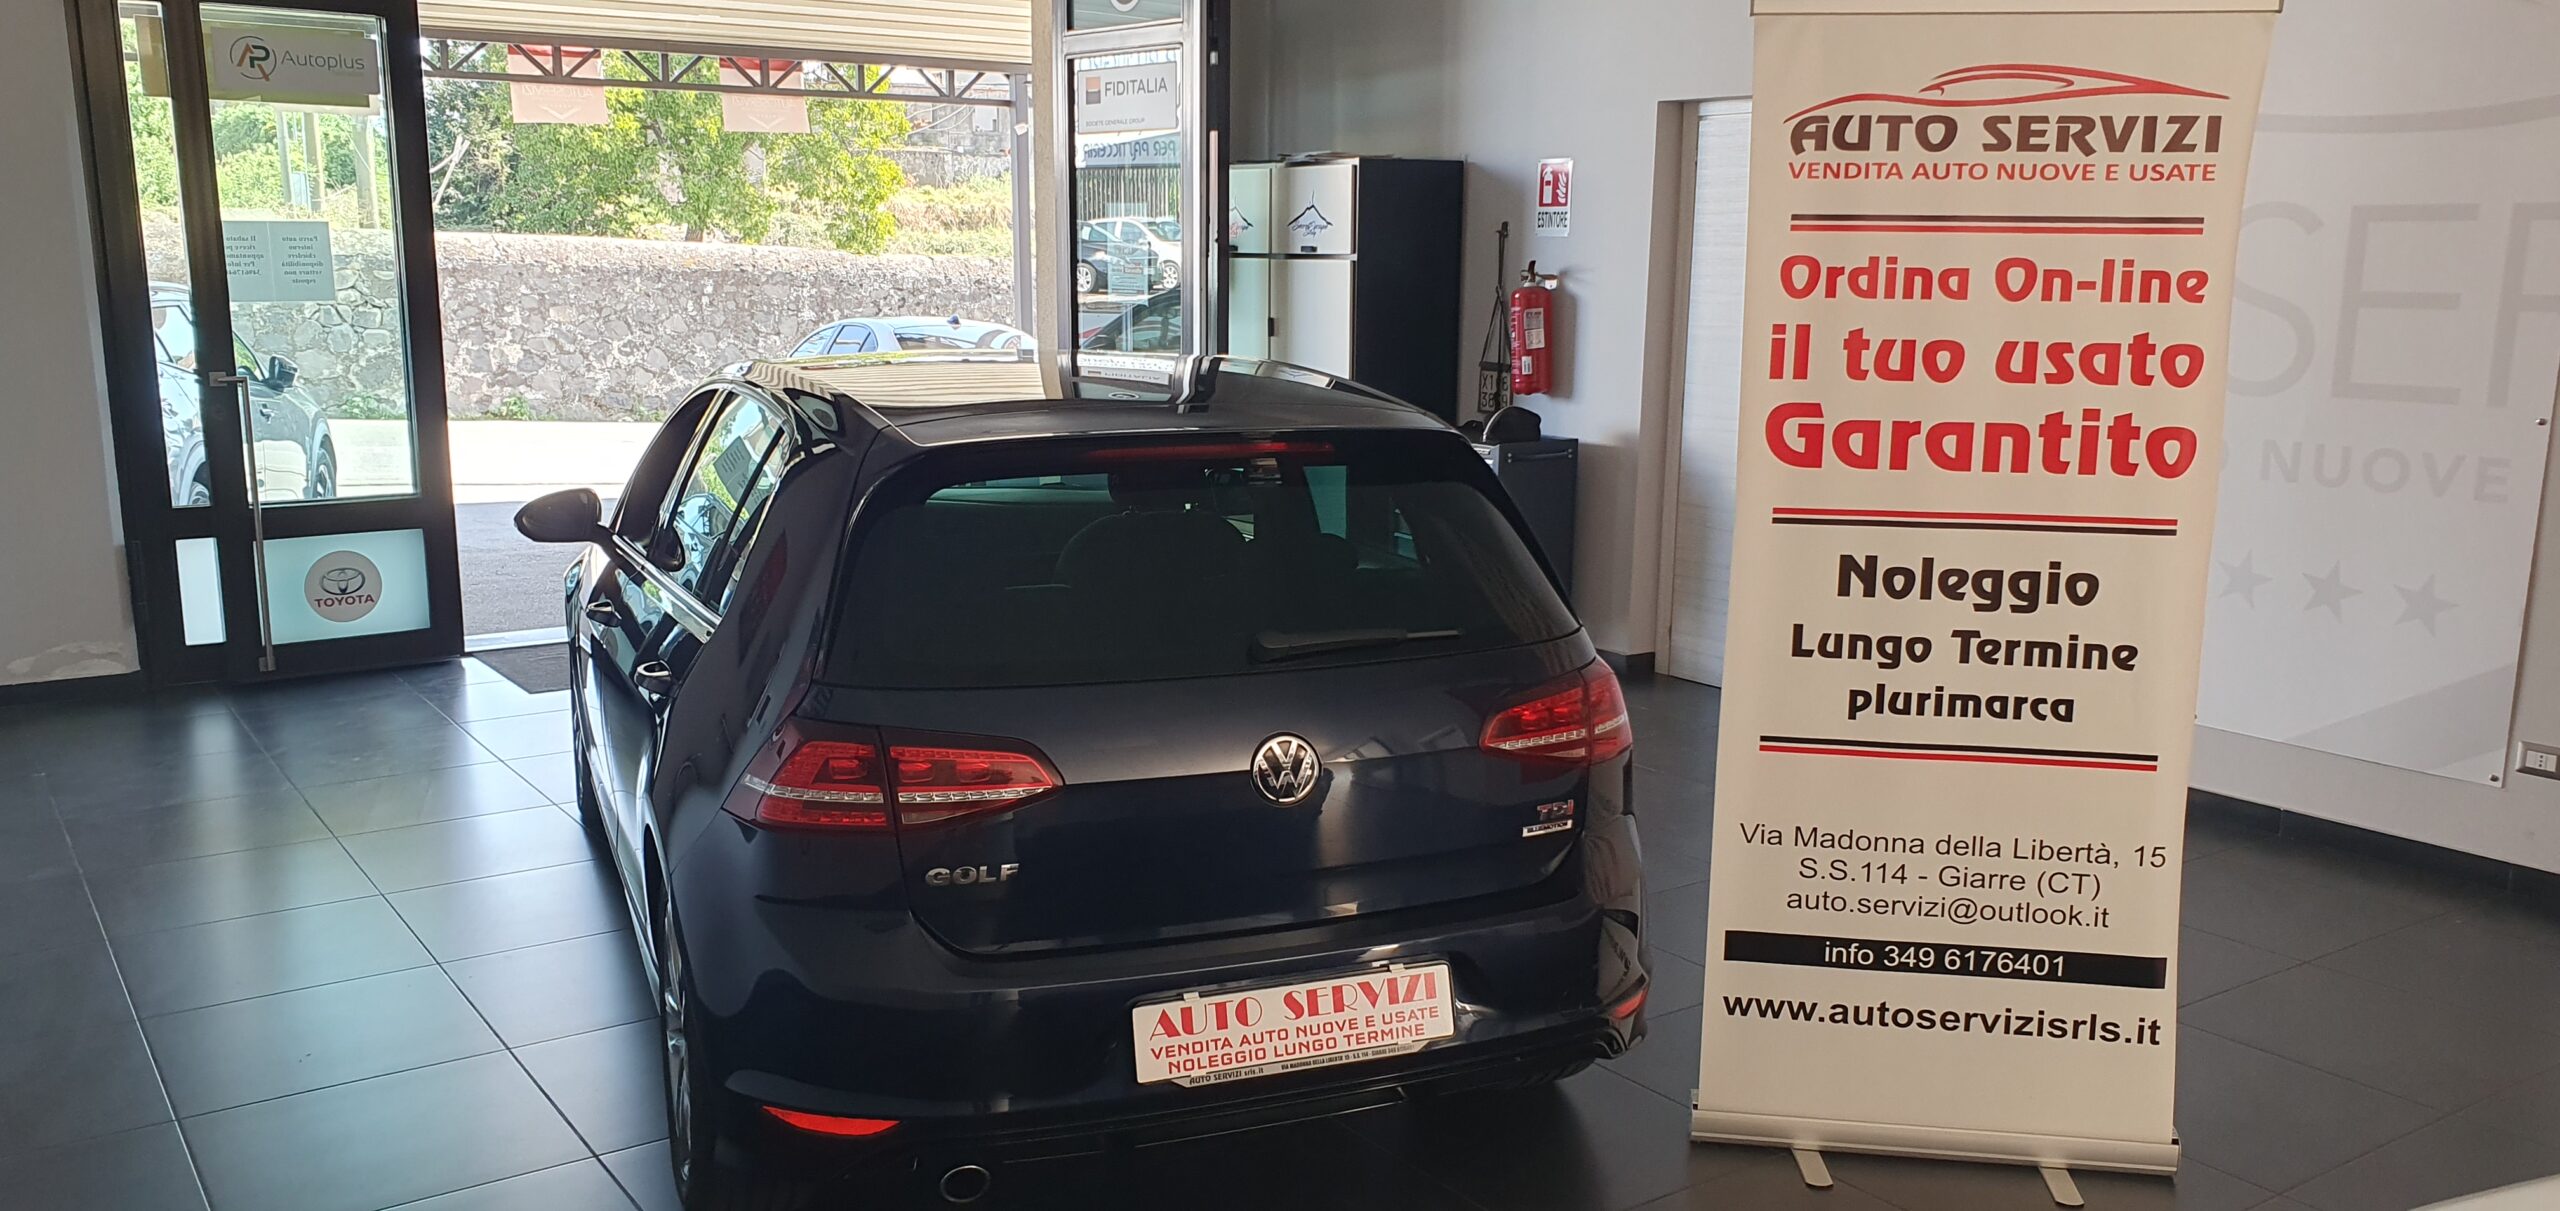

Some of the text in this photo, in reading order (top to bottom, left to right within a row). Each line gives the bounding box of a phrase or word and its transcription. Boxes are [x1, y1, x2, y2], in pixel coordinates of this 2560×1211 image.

[281, 50, 366, 71] Autoplus
[1104, 76, 1168, 97] FIDITALIA
[1789, 114, 2223, 158] AUTO SERVIZI
[1788, 161, 2217, 183] VENDITA AUTO NUOVE E USATE
[1537, 211, 1568, 229] ESTINTORE
[1779, 254, 2210, 304] Ordina On-line
[1769, 323, 2206, 389] il tuo usato
[1765, 402, 2198, 480] Garantito
[2259, 438, 2512, 503] NUOVE
[314, 593, 375, 608] TOYOTA
[1837, 554, 2100, 615] Noleggio
[1791, 623, 2139, 672] Lungo Termine
[1847, 683, 2075, 723] plurimarca
[1537, 799, 1575, 821] TDI
[1739, 822, 2167, 870] Via Madonna della Libertà, 15
[925, 863, 1020, 886] GOLF
[1798, 857, 1908, 886] S.S.114
[1938, 865, 2026, 891] Giarre
[2036, 871, 2102, 901] (CT)
[1786, 891, 2110, 928] auto.servizi@outlook.it
[1823, 941, 2065, 977] info 349 6176401
[1149, 971, 1438, 1042] AUTO SERVIZI
[1723, 994, 2162, 1047] www.autoservizisrls.it
[1150, 1005, 1440, 1061] VENDITA AUTO NUOVE E USATE
[1168, 1023, 1426, 1074] NOLEGGIO LUNGO TERMINE
[1189, 1075, 1211, 1086] AUTO
[1213, 1070, 1242, 1082] SERVIZI
